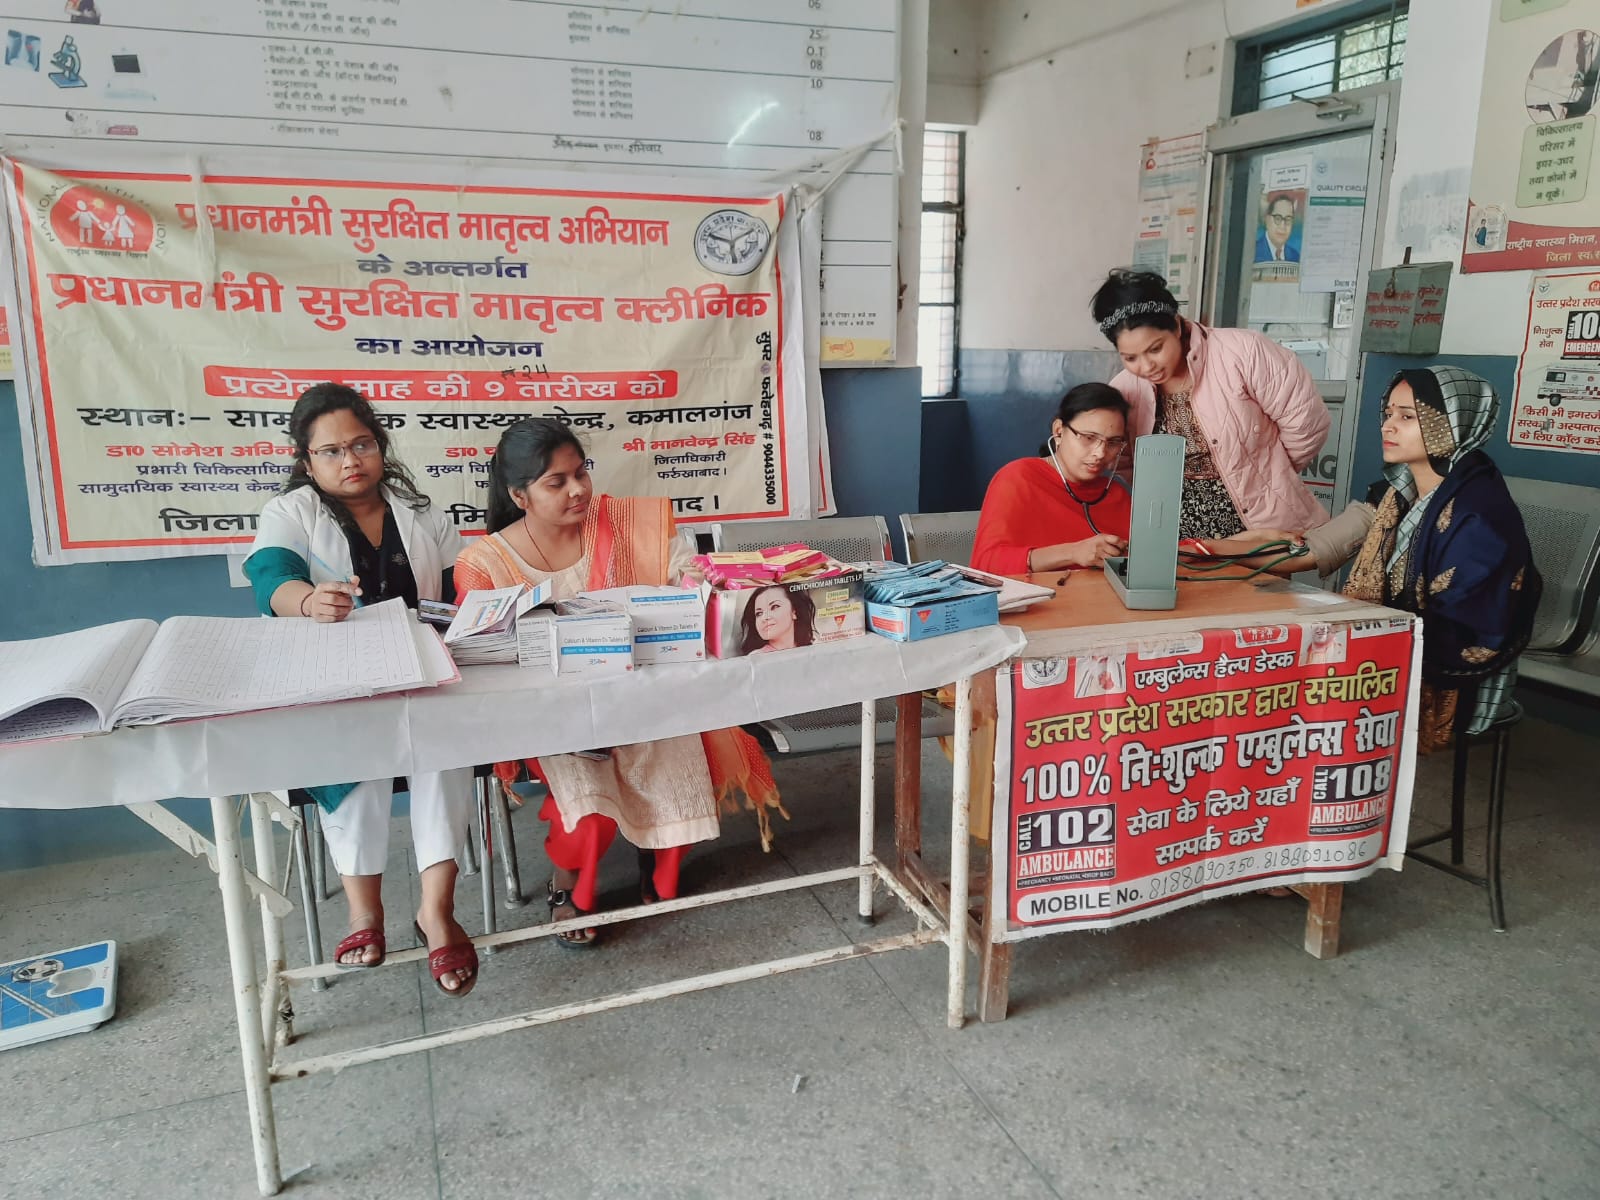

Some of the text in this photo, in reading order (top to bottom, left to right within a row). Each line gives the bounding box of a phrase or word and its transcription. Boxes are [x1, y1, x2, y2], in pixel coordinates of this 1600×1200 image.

[1539, 137, 1576, 153] परिसर में
[1317, 184, 1344, 192] QUALITY
[1529, 174, 1545, 185] तथा
[175, 195, 332, 237] प्रधानमंत्री
[340, 198, 449, 253] सुरक्षित
[458, 211, 551, 254] मातृत्व
[558, 206, 670, 246] अभियान
[1507, 237, 1533, 251] राष्ट्रीय
[1535, 236, 1567, 248] स्वास्थ्य
[356, 254, 528, 278] के अन्तर्गत
[1546, 251, 1572, 263] जिला
[47, 271, 285, 313] प्रधानमंत्री
[296, 278, 460, 331] सुरक्षित
[470, 293, 605, 333] मातृत्व
[614, 283, 772, 323] क्लीनिक
[1536, 299, 1558, 309] उत्तर
[1559, 296, 1581, 309] प्रदेश
[354, 335, 544, 358] का आयोजन
[755, 330, 772, 361] सुपर
[1539, 339, 1554, 348] सेवा
[428, 374, 471, 398] की
[484, 381, 505, 398] 9
[516, 373, 616, 398] तारीख
[629, 372, 666, 396] को
[626, 400, 753, 427] कमालगंज
[1523, 405, 1549, 416] किसी
[1551, 406, 1565, 417] भी
[623, 432, 756, 451] श्री मानवेन्द्र सिंह
[763, 432, 774, 440] #
[1519, 430, 1531, 439] के
[1533, 430, 1554, 441] लिए
[1556, 433, 1580, 444] कॉल
[152, 442, 224, 456] सोमेश
[654, 450, 726, 465] जिलाधिकारी
[136, 462, 187, 475] प्रभारी
[425, 464, 463, 477] मुख्य
[763, 443, 776, 505] 9044335000
[78, 480, 174, 497] सामुदायिक
[180, 482, 240, 493] स्वास्थ्य
[158, 507, 261, 532] जिला
[1134, 649, 1297, 692] एम्बुलेन्स हैल्प डेस्क
[1025, 661, 1400, 748] उत्तर प्रदेश सरकार द्वारा संचालित
[1021, 753, 1112, 803] 100%
[1236, 713, 1347, 776] एम्बुलेन्स
[1355, 707, 1400, 752] सेवा
[1313, 759, 1391, 800] CALL 108
[1126, 776, 1302, 836] सेवा के लिये यहाँ
[1019, 807, 1113, 851] CALL 102
[1155, 825, 1224, 866] सम्पर्क
[1228, 816, 1270, 847] करें
[1019, 847, 1114, 877] AMBULANCE
[1031, 887, 1143, 916] MOBILE No.
